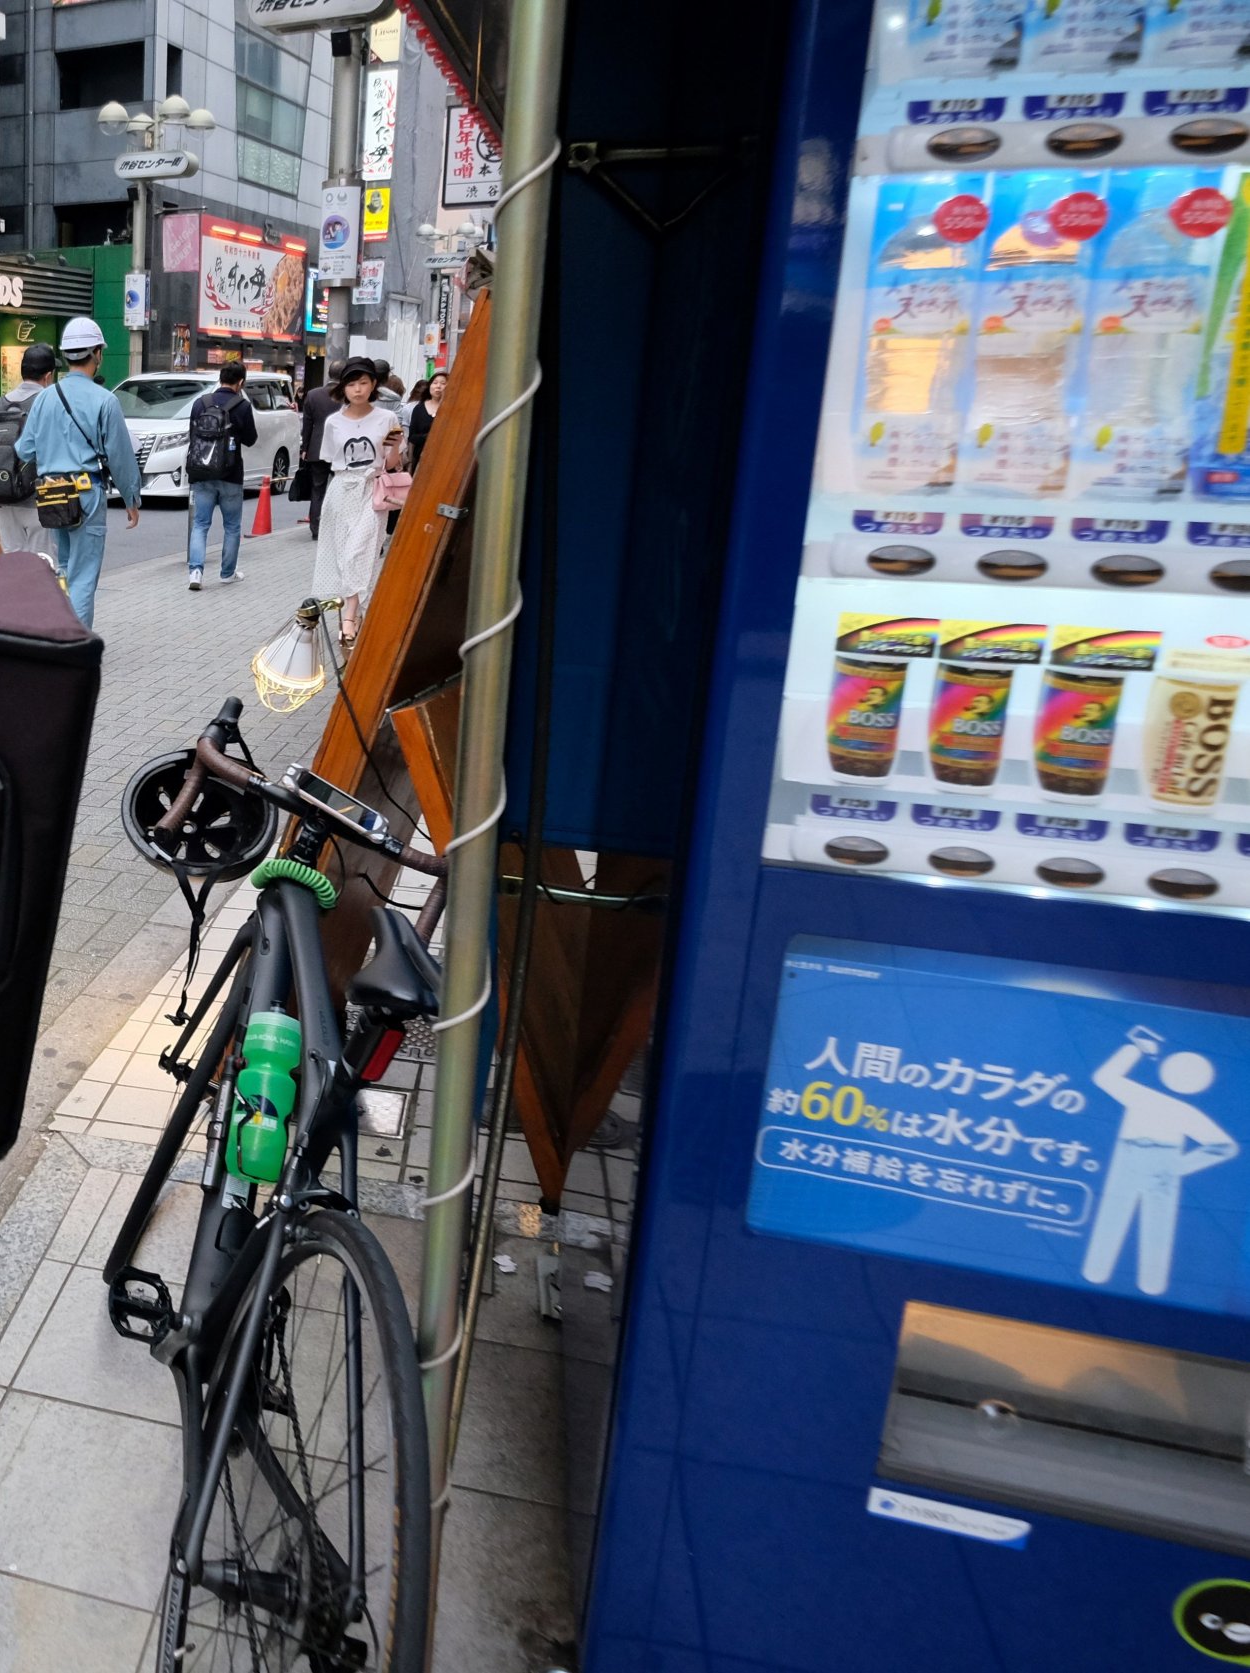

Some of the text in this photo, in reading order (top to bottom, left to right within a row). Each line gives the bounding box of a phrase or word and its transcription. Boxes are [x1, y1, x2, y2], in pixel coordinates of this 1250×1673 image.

[849, 709, 896, 728] BOSS
[952, 717, 1000, 737] BOSS
[1060, 725, 1113, 745] BOSS
[1186, 697, 1235, 798] BOSS
[805, 1036, 1086, 1115] 人間のカラダの
[766, 1080, 1100, 1173] 約60%は水分です。
[778, 1138, 1072, 1215] 水分補給を忘れずに。
